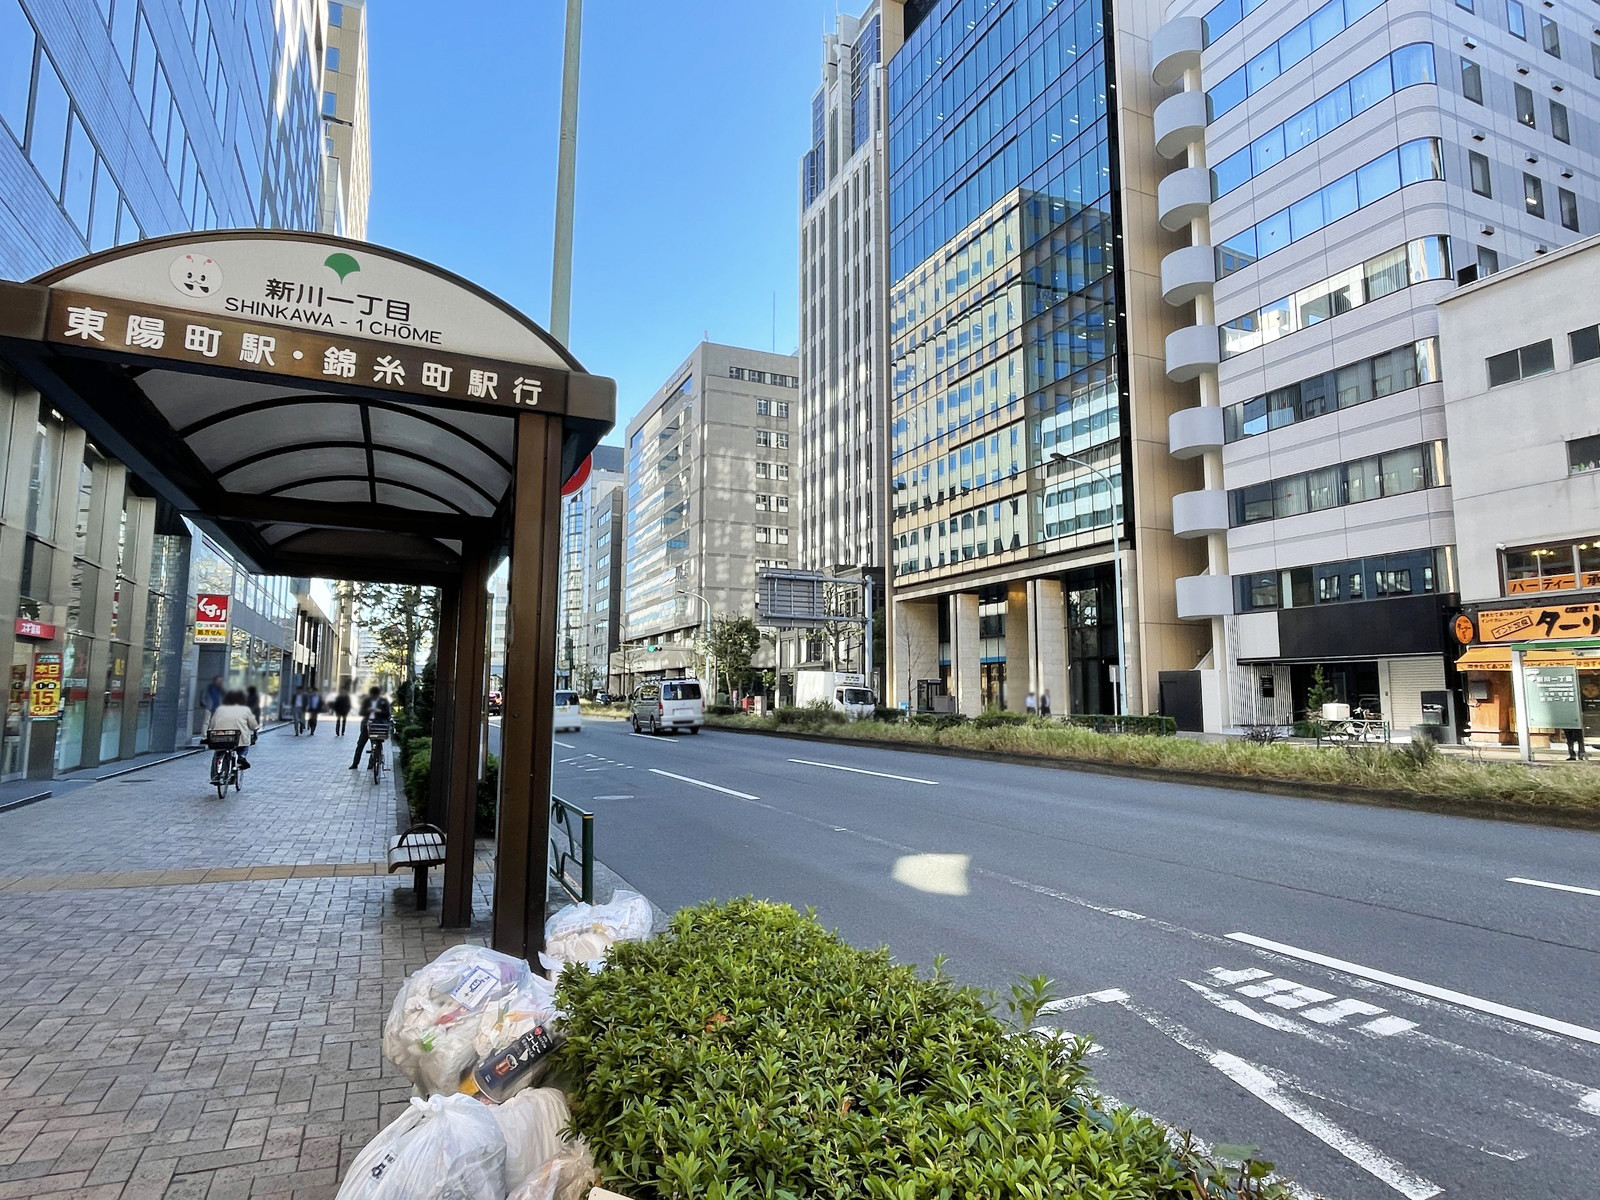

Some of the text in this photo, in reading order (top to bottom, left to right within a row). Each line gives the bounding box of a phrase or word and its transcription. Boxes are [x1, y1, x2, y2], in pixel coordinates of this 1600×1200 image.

[224, 297, 334, 327] SHINKAWA
[265, 278, 410, 322] 新川一丁目
[64, 305, 543, 407] 東陽町駅・錦糸町駅行
[198, 597, 227, 621] くすり
[35, 664, 60, 675] 本日
[526, 1033, 541, 1054] コーヒー
